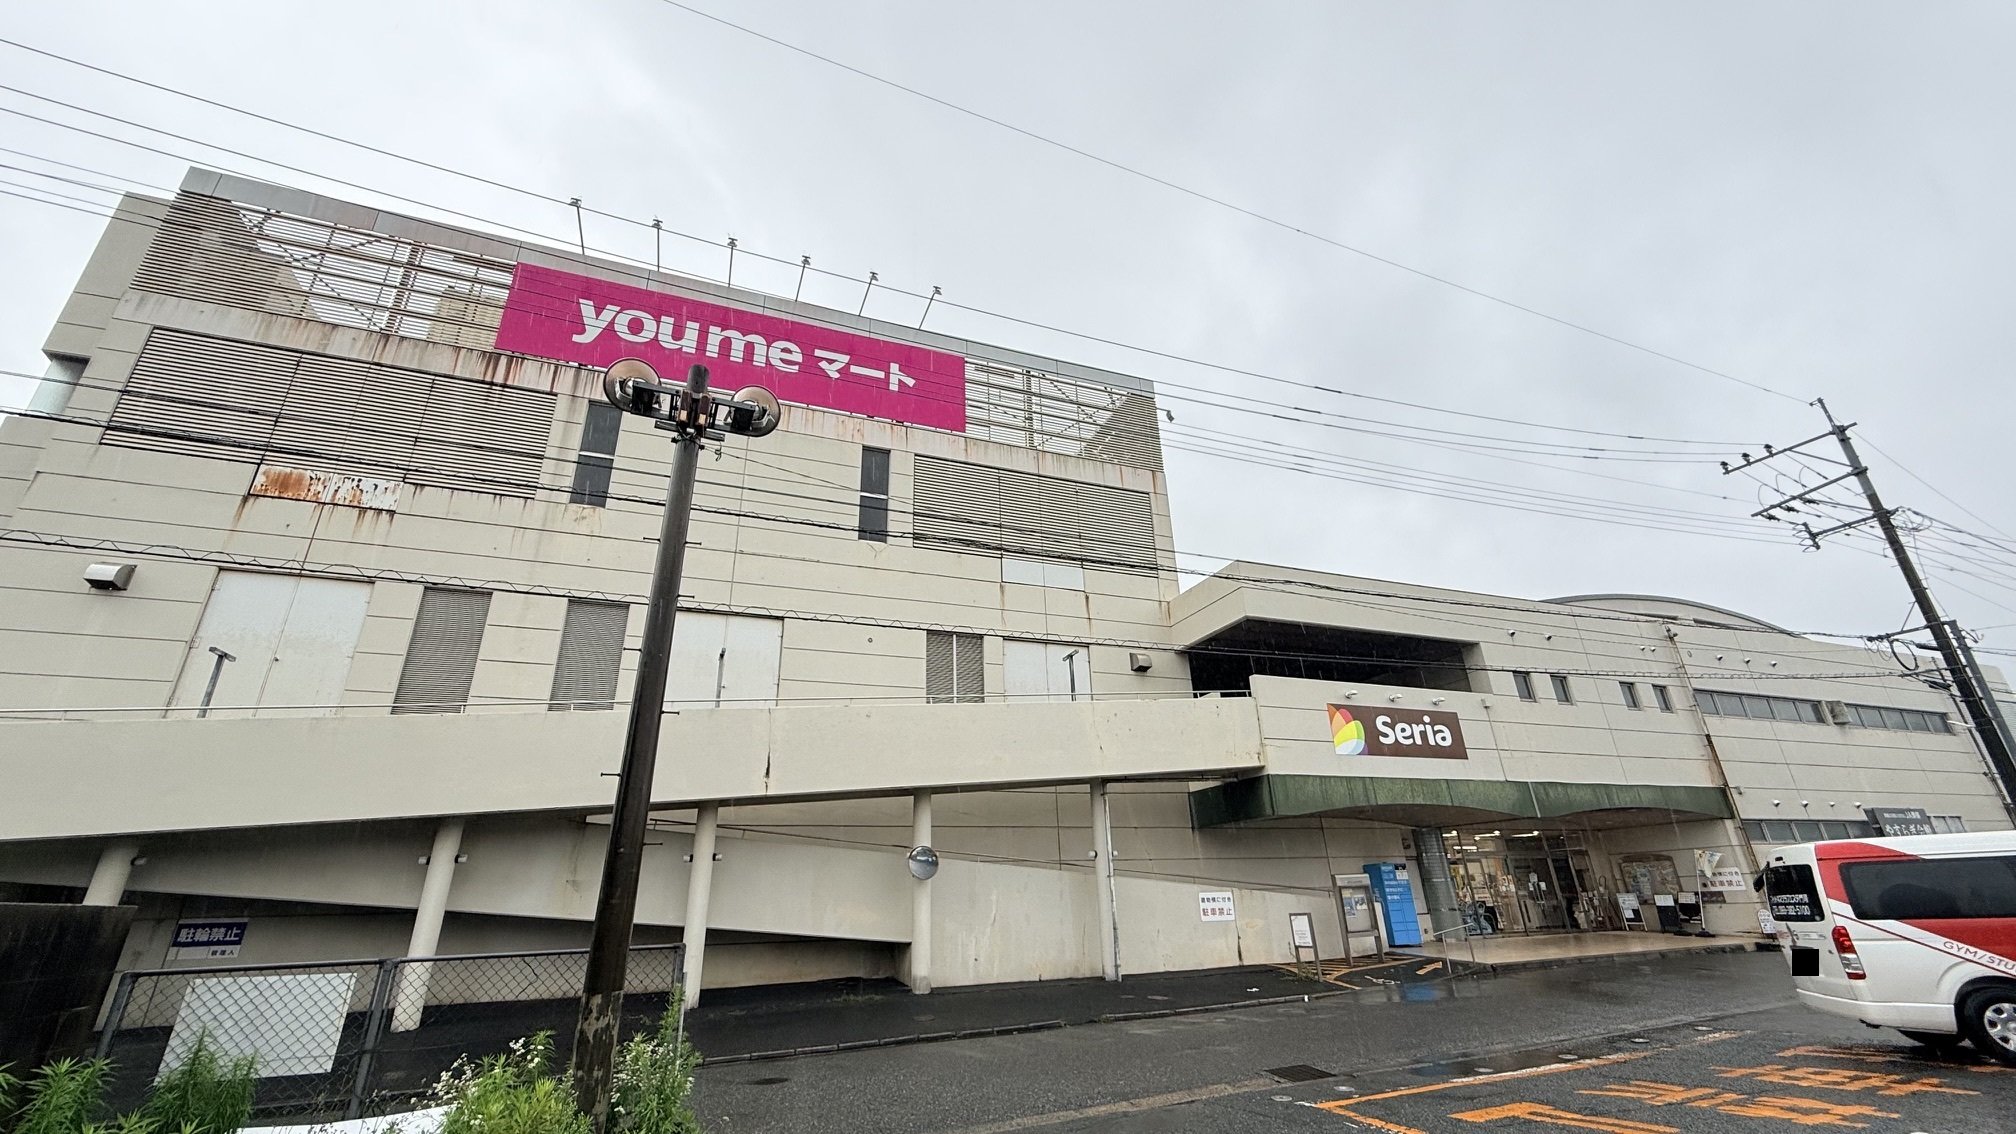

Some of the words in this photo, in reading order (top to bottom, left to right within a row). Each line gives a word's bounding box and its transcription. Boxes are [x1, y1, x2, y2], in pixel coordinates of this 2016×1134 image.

[812, 347, 917, 392] マート
[1375, 714, 1453, 747] Seria
[1709, 880, 1744, 888] 駐車禁止
[1201, 907, 1233, 917] 駐車禁止
[176, 926, 241, 943] 駐輪禁止
